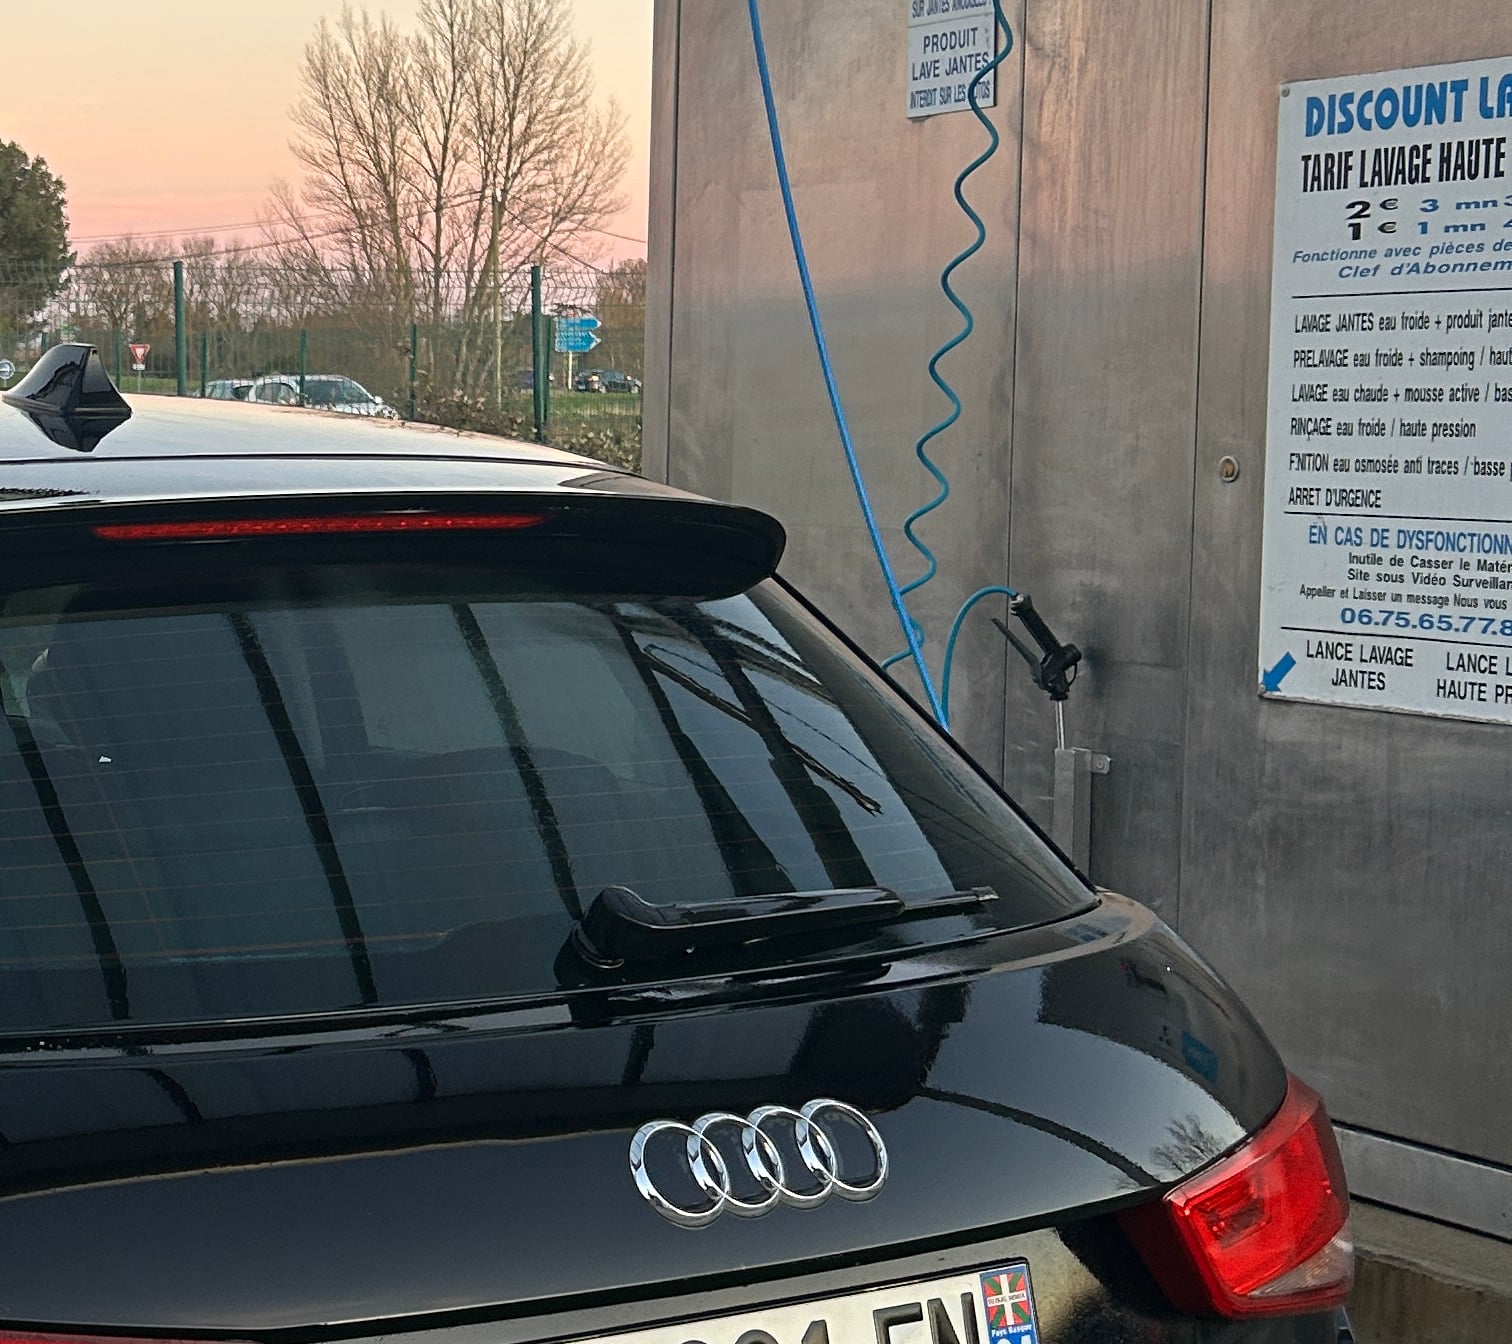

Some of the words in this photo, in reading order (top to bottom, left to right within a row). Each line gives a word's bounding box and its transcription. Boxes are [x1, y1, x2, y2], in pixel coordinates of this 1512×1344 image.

[923, 27, 978, 54] PRODUIT
[912, 59, 940, 81] LAVE
[945, 51, 990, 76] JANTES
[1305, 79, 1468, 137] DISCOUNT
[1301, 151, 1354, 193] TARIF
[1360, 143, 1433, 188] LAVAGE
[1438, 137, 1507, 183] HAUTE
[1419, 199, 1439, 213] 3
[1456, 198, 1498, 209] mn
[1348, 222, 1362, 241] 1
[1418, 221, 1429, 235] 1
[1444, 222, 1486, 234] mn
[1292, 247, 1377, 264] Fonctionne
[1384, 244, 1421, 258] avec
[1429, 241, 1485, 259] pièces
[1338, 264, 1380, 279] Clef
[1295, 313, 1331, 334] LAVAGE
[1335, 312, 1374, 332] JANTES
[1378, 315, 1397, 332] eau
[1401, 311, 1430, 331] froide
[1434, 317, 1442, 330] +
[1446, 309, 1483, 334] produit
[1293, 349, 1349, 369] PRELAVAGE
[1353, 352, 1371, 368] eau
[1374, 348, 1403, 367] froide
[1419, 346, 1475, 372] shampoing
[1292, 384, 1329, 403] LAVAGE
[1332, 387, 1350, 403] eau
[1354, 383, 1389, 403] chaude
[1393, 389, 1401, 402] +
[1404, 387, 1444, 403] mousse
[1449, 382, 1480, 403] active
[1290, 417, 1332, 442] RINÇAGE
[1336, 421, 1354, 437] eau
[1358, 418, 1386, 437] froide
[1399, 417, 1427, 437] haute
[1431, 417, 1476, 443] pression
[1333, 457, 1351, 473] eau
[1354, 453, 1399, 474] osmosée
[1403, 455, 1423, 475] anti
[1427, 456, 1459, 476] traces
[1473, 456, 1506, 477] basse
[1288, 487, 1322, 506] ARRET
[1325, 488, 1382, 509] D'URGENCE
[1309, 524, 1328, 545] EN
[1334, 525, 1363, 548] CAS
[1370, 528, 1390, 549] DE
[1348, 552, 1384, 567] Inutile
[1389, 554, 1405, 568] de
[1410, 555, 1453, 571] Casser
[1459, 557, 1471, 571] le
[1347, 568, 1371, 582] Site
[1376, 573, 1405, 584] sous
[1412, 571, 1447, 587] Vidéo
[1353, 587, 1387, 602] Laisser
[1391, 592, 1403, 603] un
[1406, 593, 1449, 610] message
[1453, 593, 1478, 609] Nous
[1484, 597, 1508, 611] vous
[1306, 640, 1354, 662] LANCE
[1359, 643, 1414, 667] LAVAGE
[1446, 651, 1498, 675] LANCE
[1331, 668, 1386, 691] JANTES
[1436, 678, 1488, 703] HAUTE
